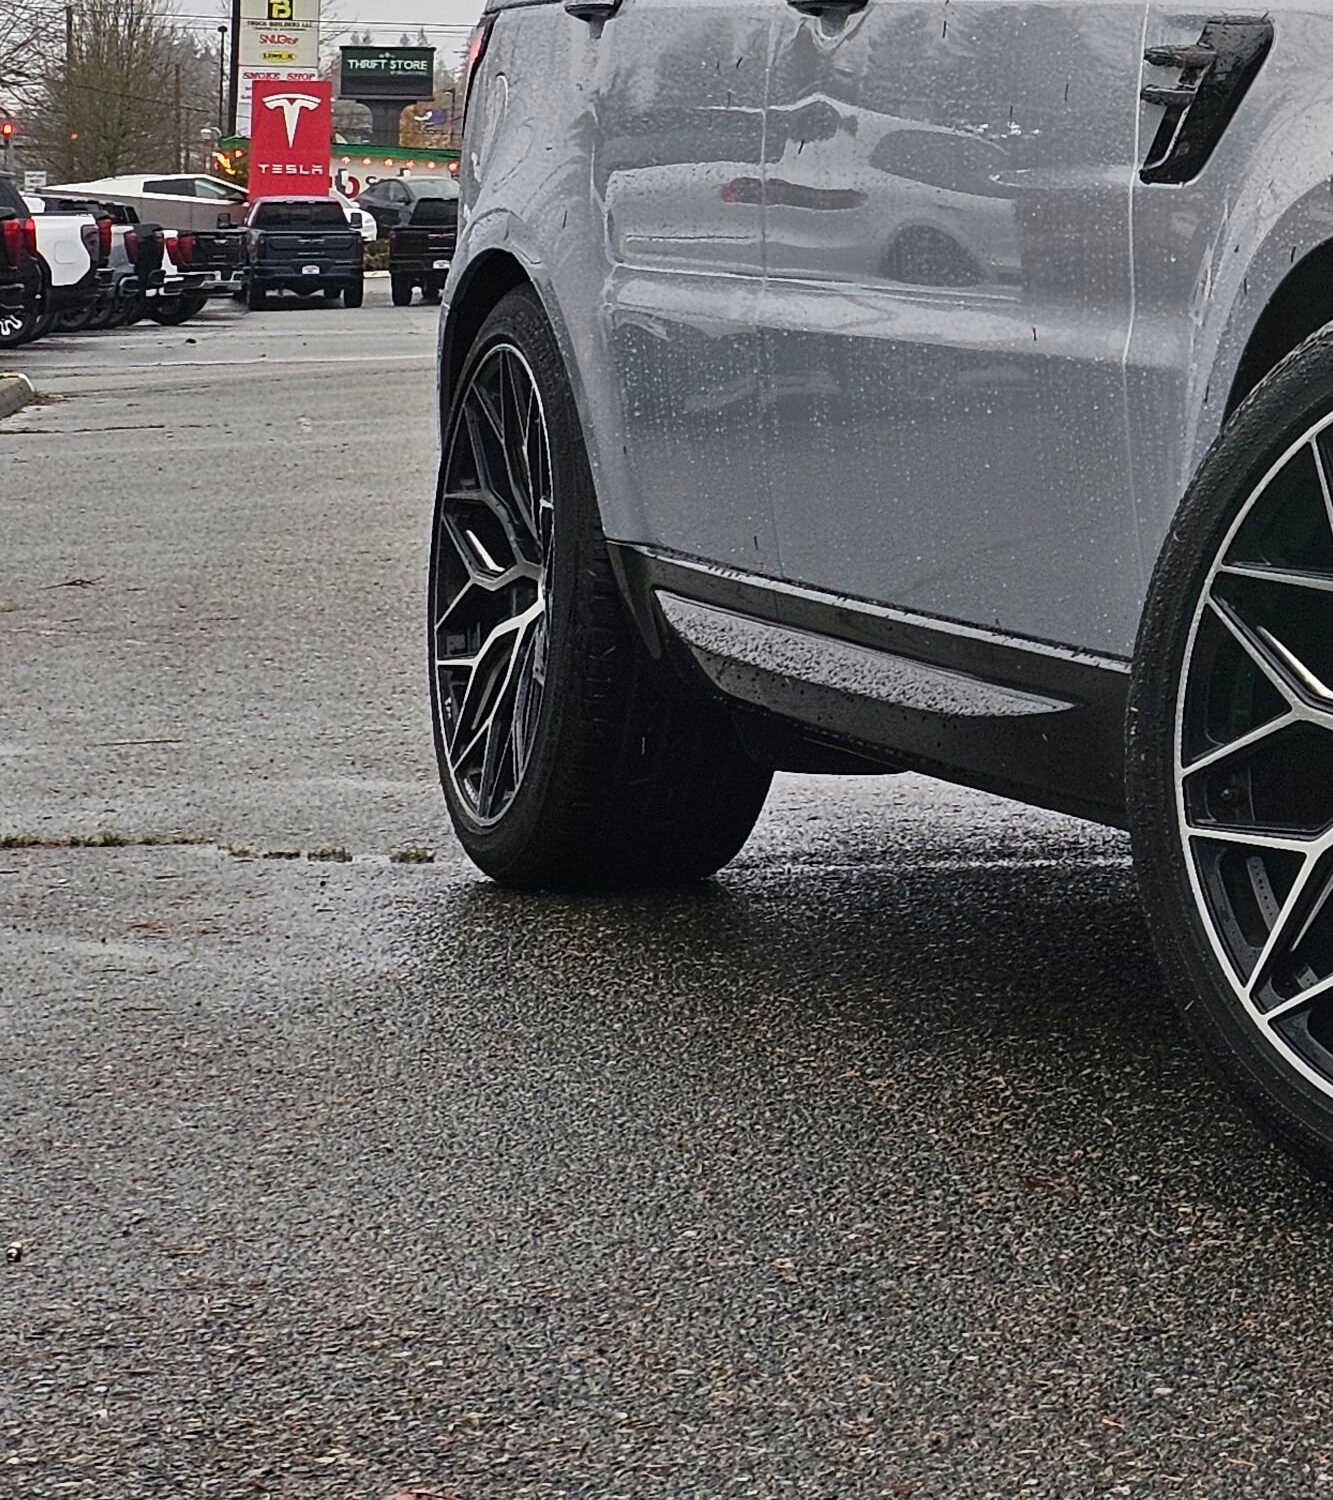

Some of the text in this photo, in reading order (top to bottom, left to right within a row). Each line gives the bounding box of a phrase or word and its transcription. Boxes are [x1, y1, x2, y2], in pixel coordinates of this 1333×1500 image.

[347, 59, 428, 70] THRIFT STORE
[287, 72, 316, 81] SHOP
[257, 163, 324, 175] TESLA
